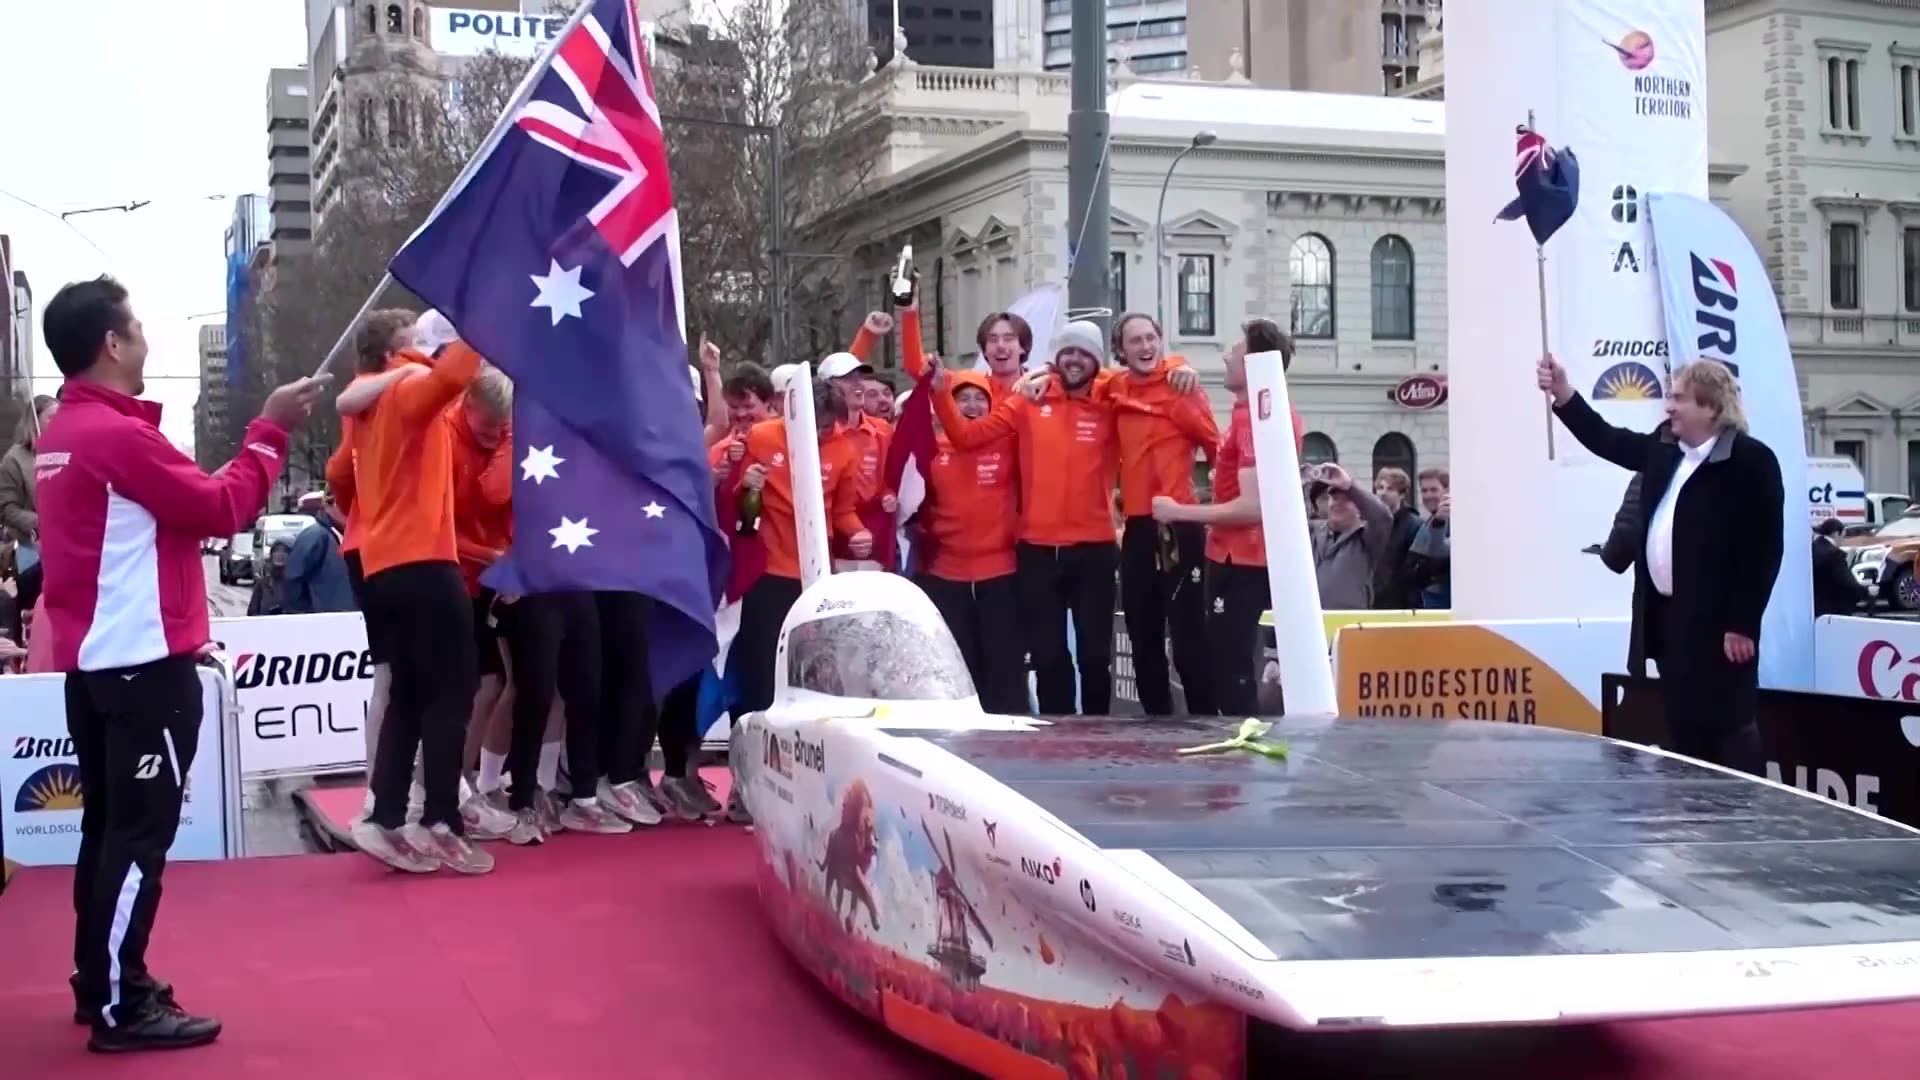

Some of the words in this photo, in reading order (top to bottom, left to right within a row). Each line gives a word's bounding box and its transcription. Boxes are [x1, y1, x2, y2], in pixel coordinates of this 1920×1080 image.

[1634, 76, 1691, 97] NORTHERN
[1635, 96, 1691, 119] TERRITORY
[236, 650, 375, 690] BRIDGE
[1358, 666, 1533, 700] BRIDGESTONE
